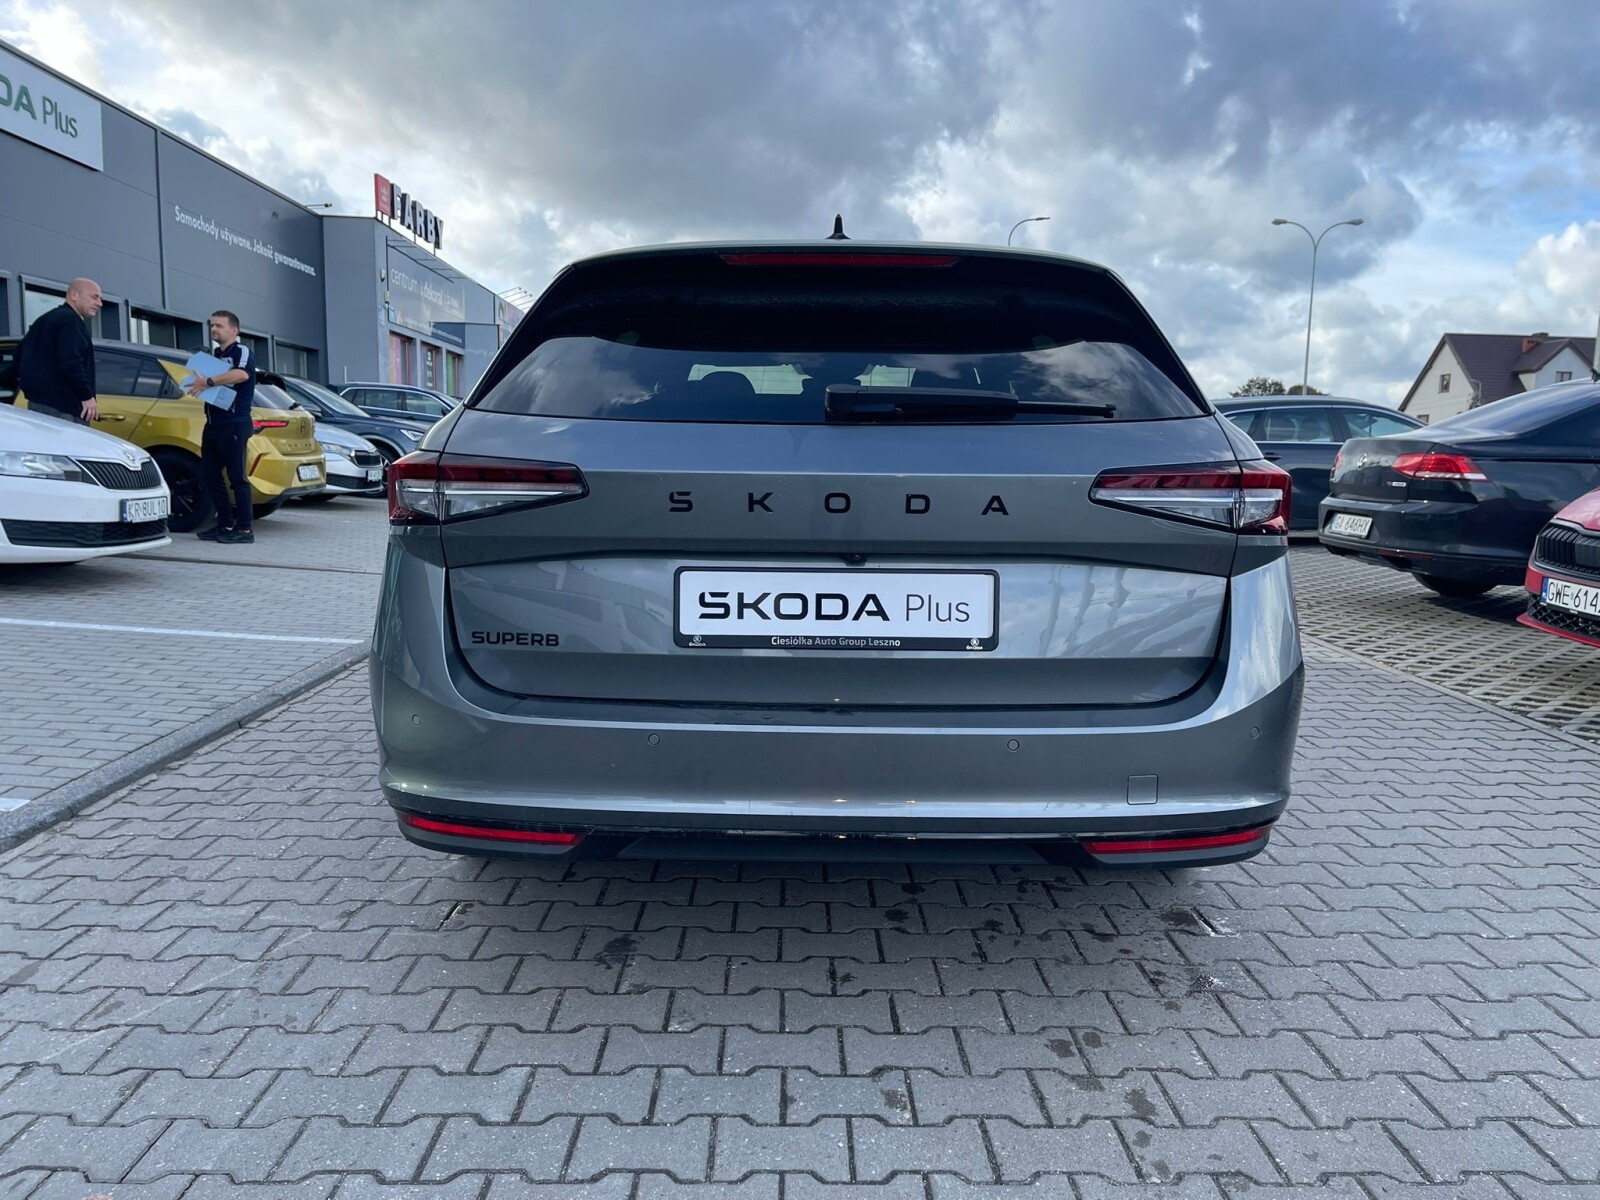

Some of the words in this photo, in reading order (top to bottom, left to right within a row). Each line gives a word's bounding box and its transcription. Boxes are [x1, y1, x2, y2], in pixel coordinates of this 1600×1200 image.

[42, 95, 78, 138] Plus
[174, 205, 219, 241] Samochody
[391, 183, 444, 249] FARBY
[390, 268, 419, 294] centrum
[905, 594, 971, 622] Plus
[1548, 581, 1571, 606] GWE
[1573, 588, 1600, 614] 614
[471, 630, 560, 647] SUPERB
[814, 637, 837, 646] Auto
[838, 638, 867, 648] Group
[868, 637, 901, 647] Leszno
